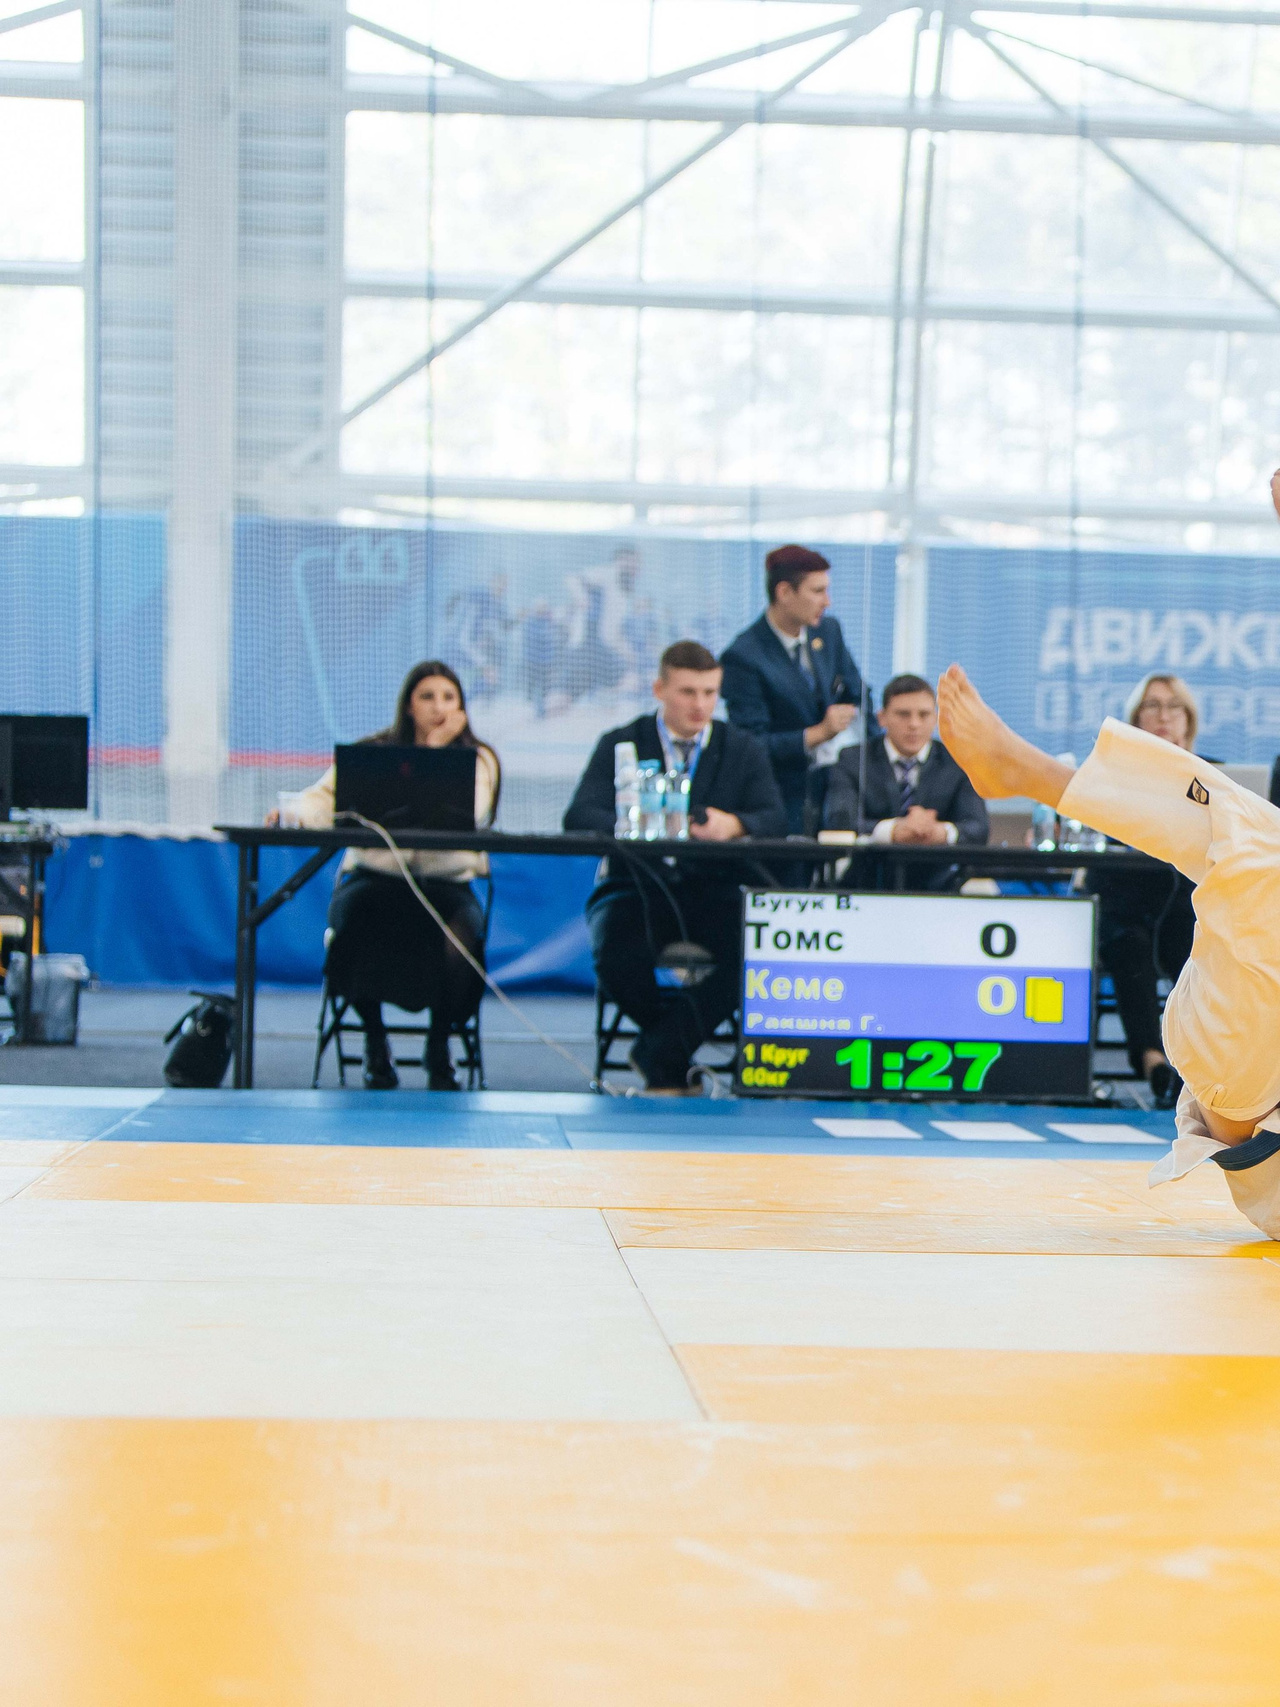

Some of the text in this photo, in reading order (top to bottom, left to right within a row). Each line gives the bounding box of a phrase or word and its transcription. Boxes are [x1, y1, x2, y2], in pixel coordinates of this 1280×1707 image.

[745, 922, 1017, 959] Томс 0
[745, 968, 1018, 1016] Кеме 0
[860, 1014, 883, 1032] Г.
[743, 1042, 810, 1069] 1 Круг
[835, 1038, 1003, 1092] 1:27
